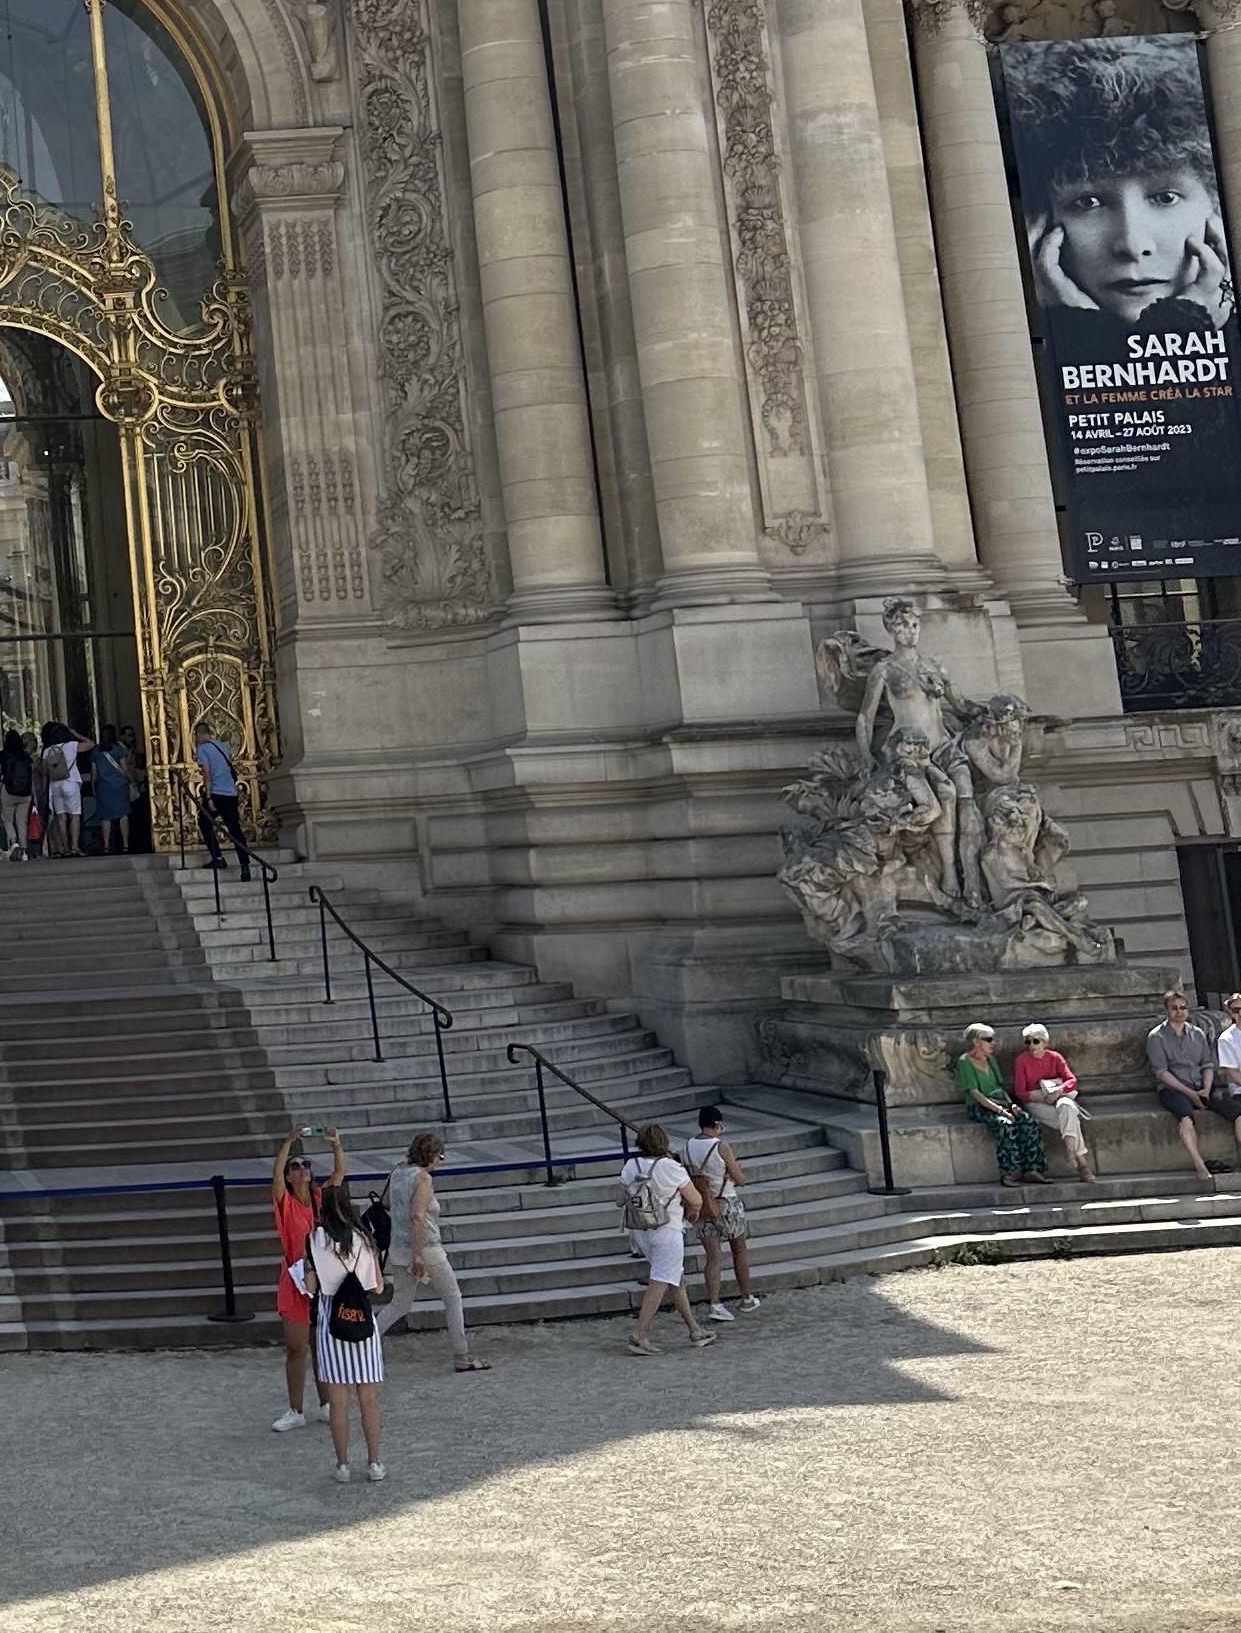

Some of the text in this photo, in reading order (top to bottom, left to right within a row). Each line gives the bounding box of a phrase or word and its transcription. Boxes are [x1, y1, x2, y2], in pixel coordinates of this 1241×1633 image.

[1127, 330, 1226, 358] SARAH
[1061, 357, 1229, 389] BERNHARDT
[1065, 386, 1233, 405] ET LA FEMME CRÉA LA STAR
[1068, 410, 1165, 427] PETIT PALAIS
[1071, 430, 1083, 439] 14
[1085, 429, 1114, 439] AVRIL
[1123, 428, 1134, 437] 27
[1136, 424, 1165, 436] AOÛT
[1167, 424, 1192, 435] 2023
